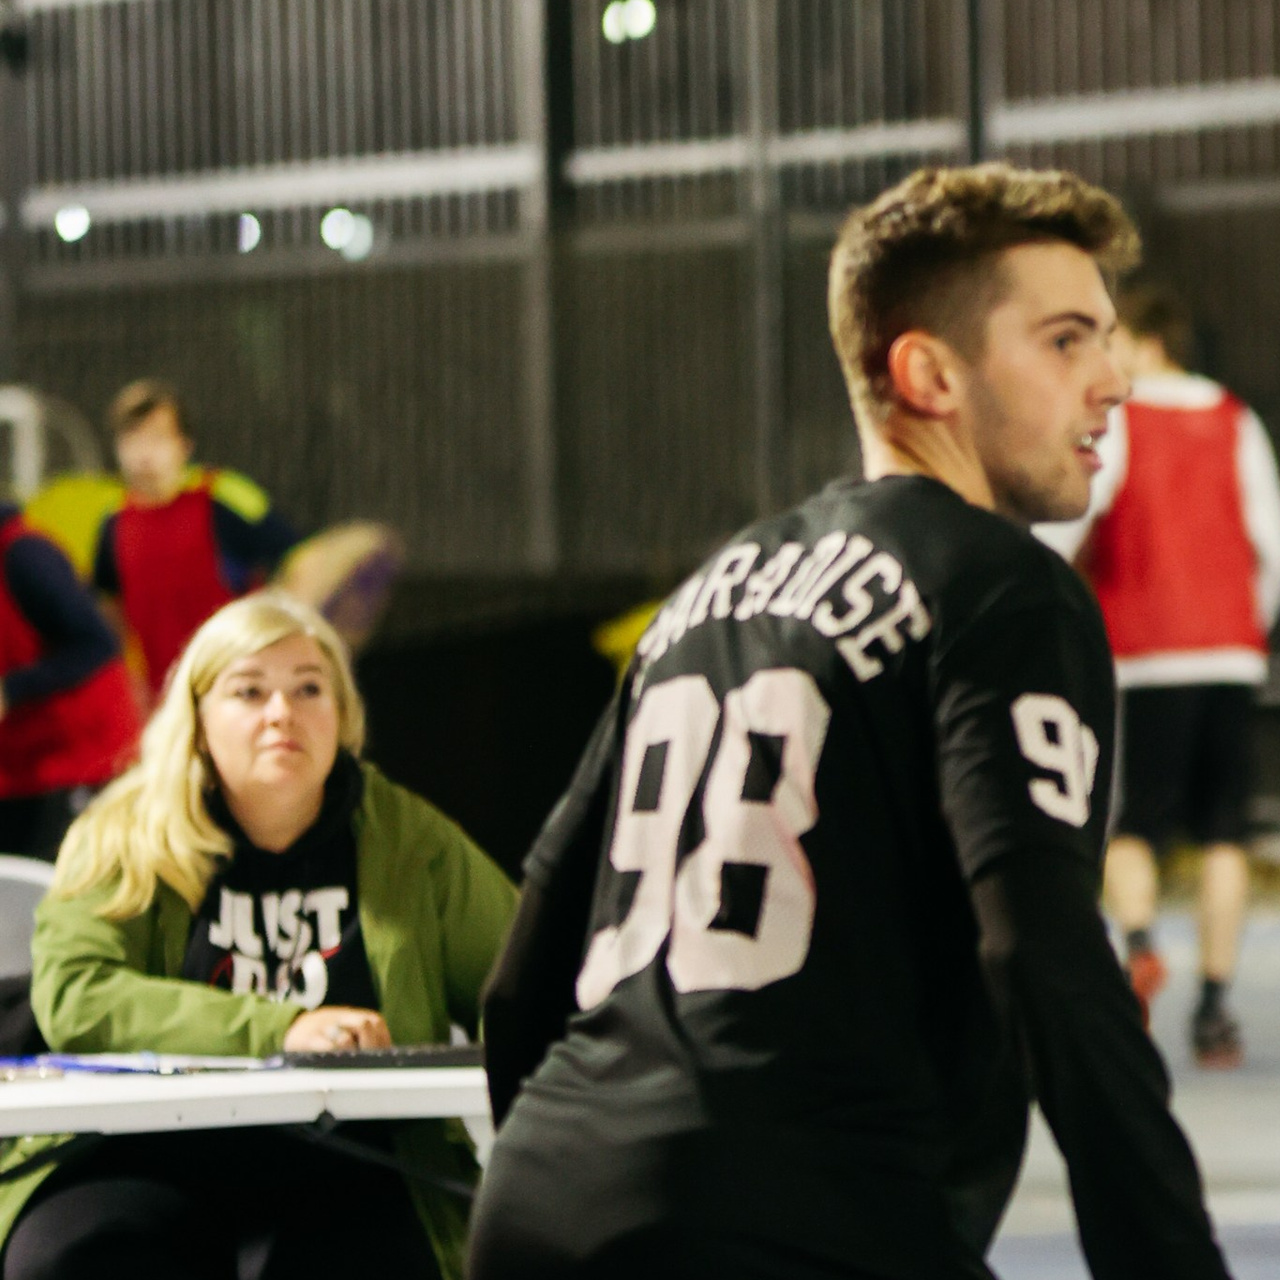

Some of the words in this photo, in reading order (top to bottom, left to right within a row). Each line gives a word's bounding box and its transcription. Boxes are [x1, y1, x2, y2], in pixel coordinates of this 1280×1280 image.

[632, 530, 932, 684] ARADISE
[575, 666, 833, 1011] 98
[208, 886, 349, 960] JUST
